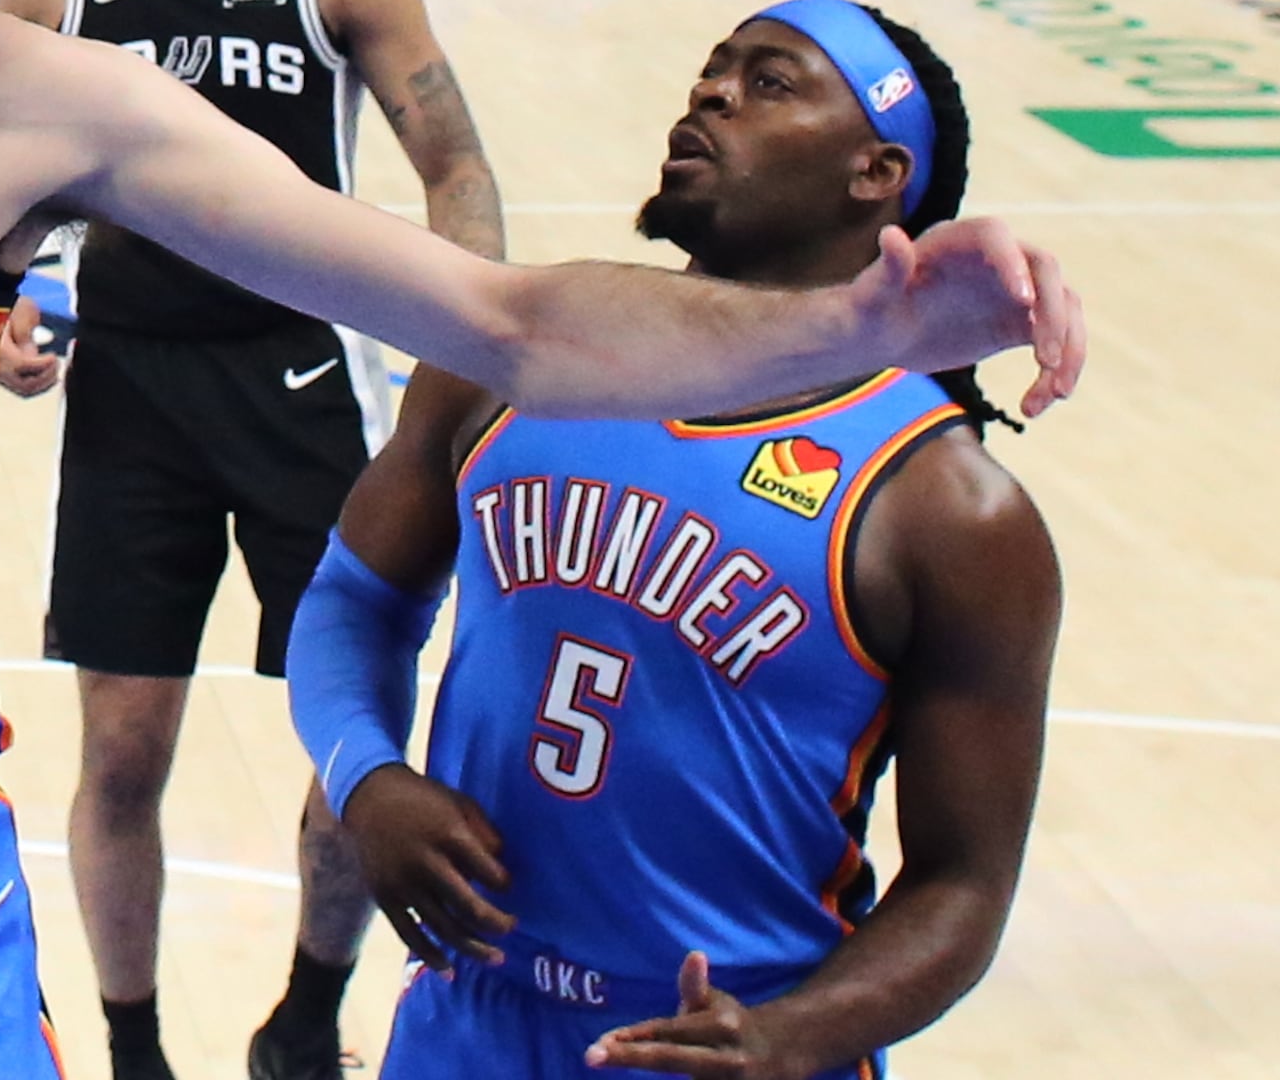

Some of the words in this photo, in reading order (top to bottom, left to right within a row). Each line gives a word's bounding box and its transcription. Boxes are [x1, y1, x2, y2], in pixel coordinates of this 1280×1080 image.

[472, 475, 810, 688] THUNDER
[529, 632, 633, 799] 5
[534, 955, 605, 1004] OKC
